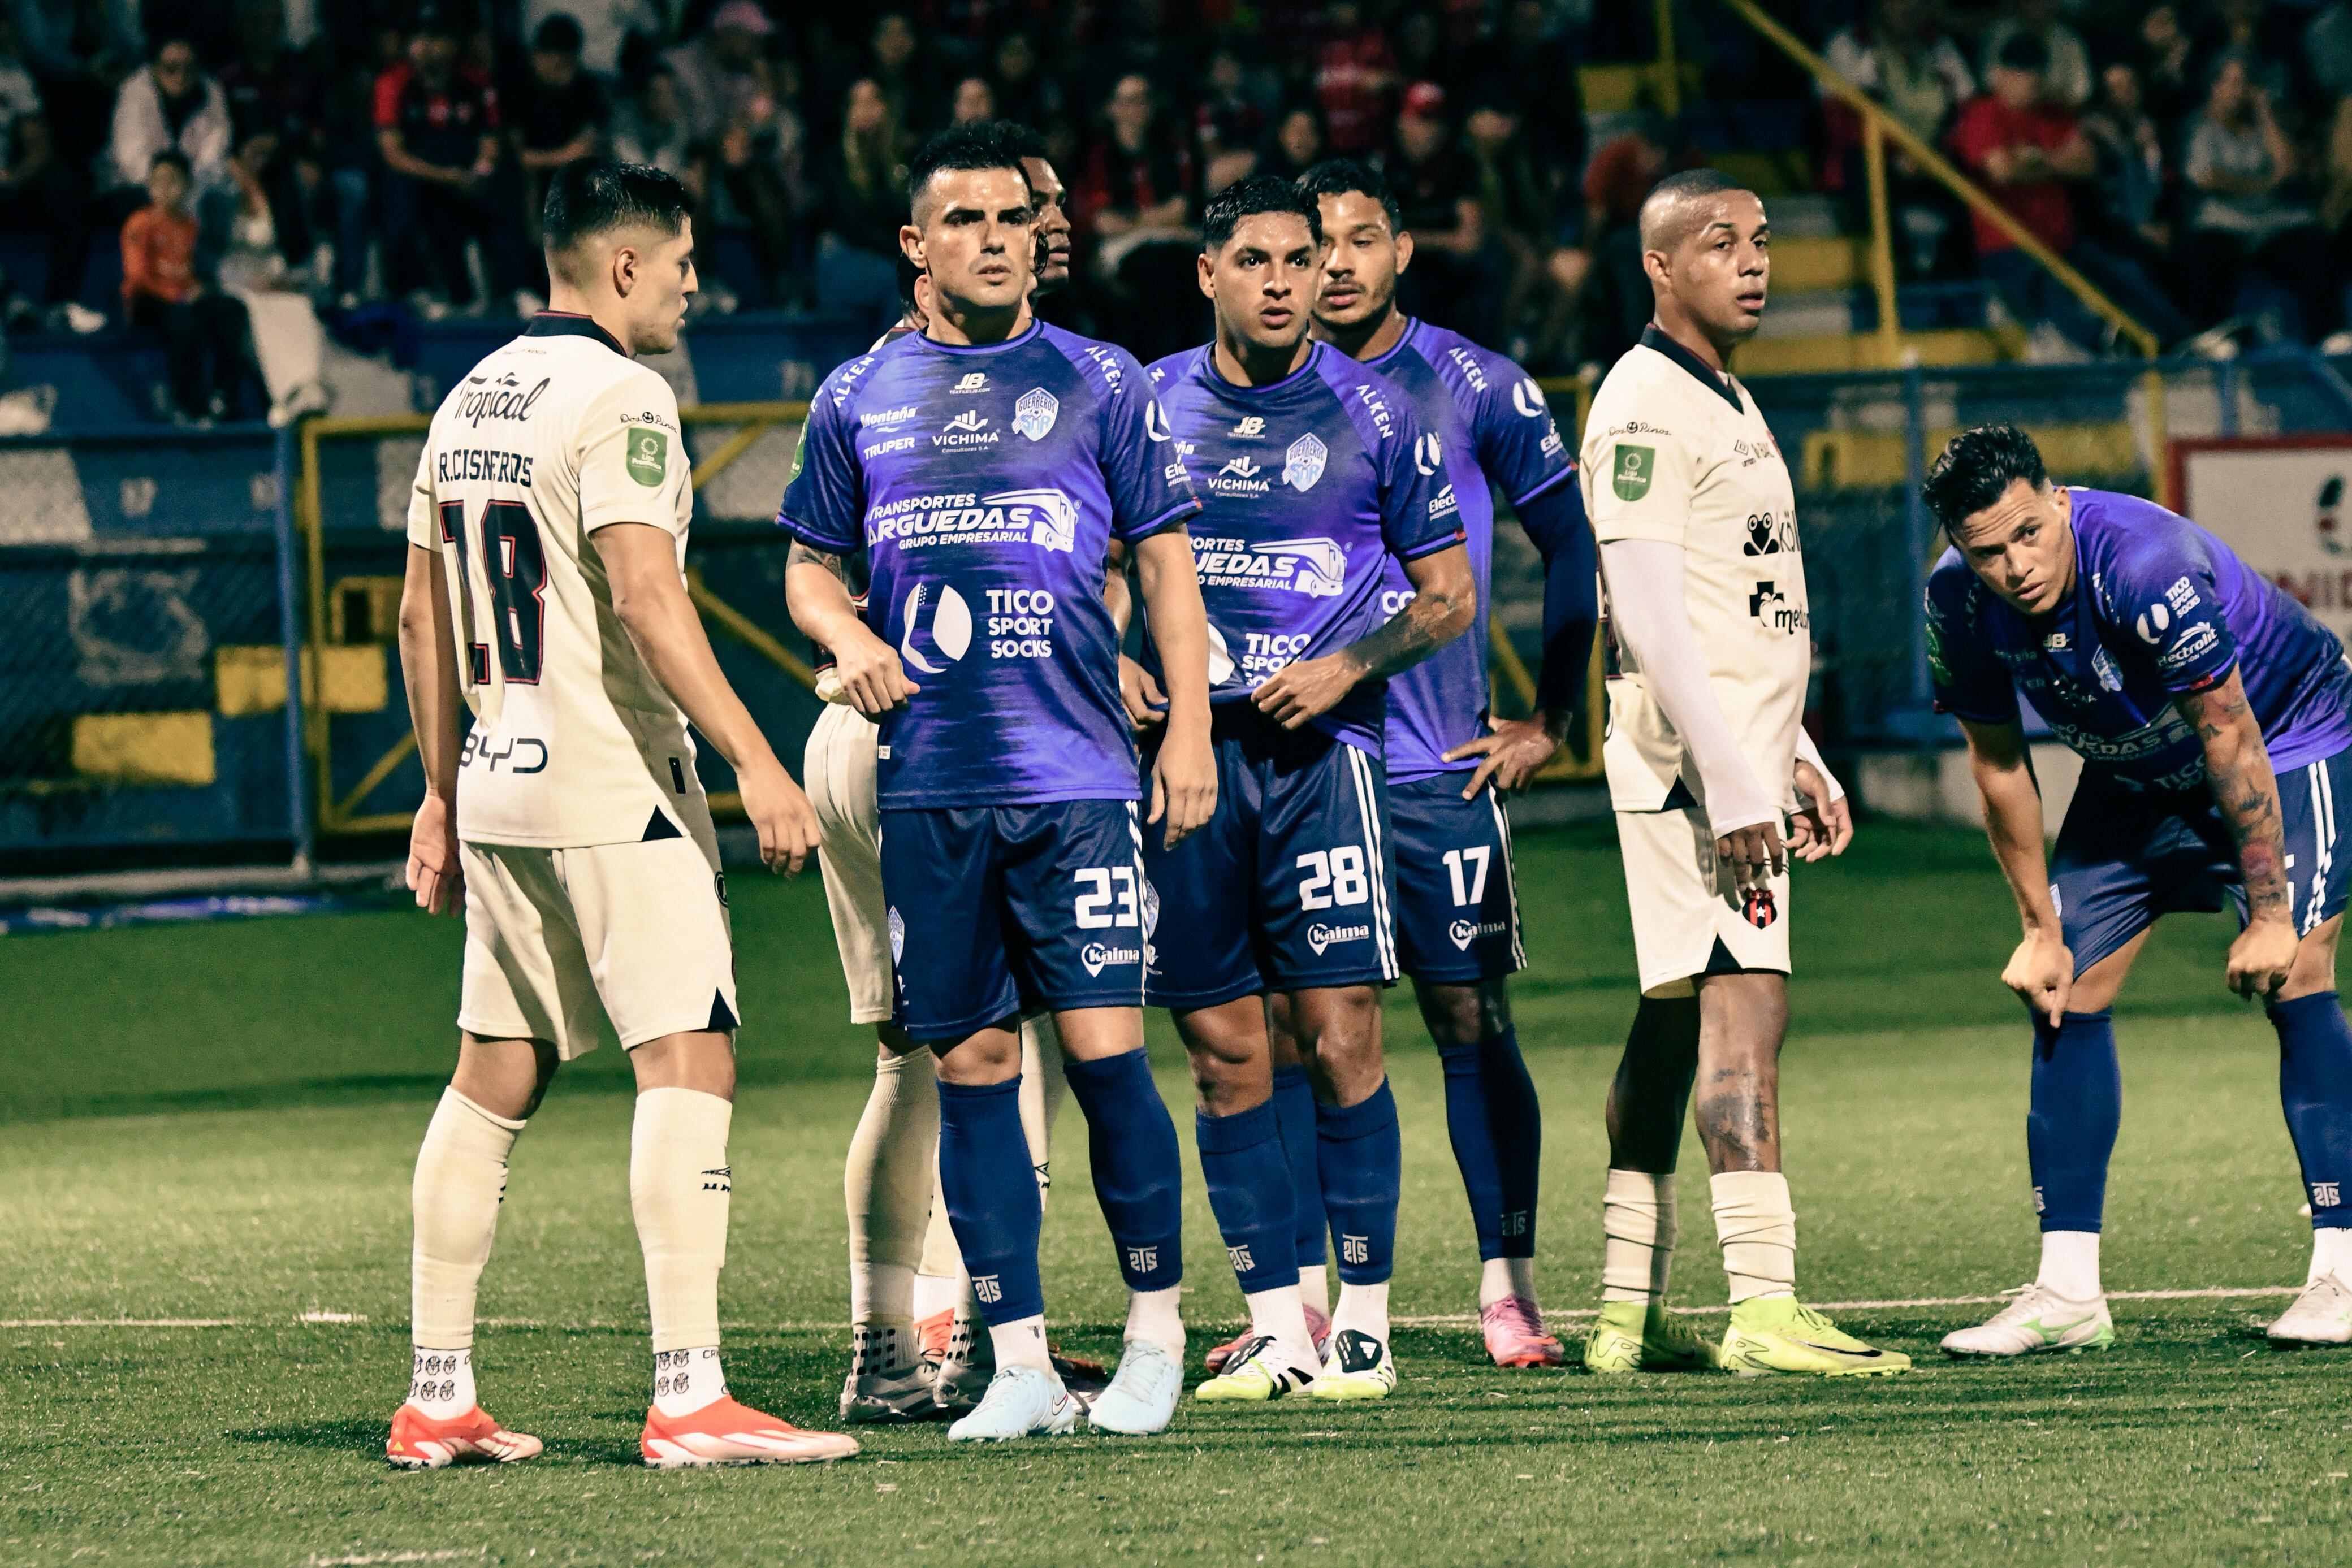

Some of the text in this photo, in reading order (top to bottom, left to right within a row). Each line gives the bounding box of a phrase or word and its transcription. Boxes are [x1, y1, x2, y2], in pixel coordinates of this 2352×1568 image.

[954, 372, 989, 389] JB
[1447, 346, 1488, 393] ALKEN
[833, 357, 875, 408] ALKEN
[455, 372, 550, 428] Tropical
[1018, 396, 1056, 413] GUERREROS
[1356, 384, 1394, 439] ALKEN
[1234, 416, 1266, 434] JB
[1609, 422, 1672, 436] Dos Pinos
[863, 437, 915, 460] TRUPER
[932, 432, 999, 446] VICHIMA
[1289, 443, 1324, 461] GUERREROS
[439, 449, 534, 487] R.CISNEROS
[1208, 478, 1270, 492] VICHIMA
[869, 493, 977, 521] TRANSPORTES
[1429, 492, 1456, 514] Elect
[868, 508, 1034, 548] ARGUEDAS
[898, 531, 1028, 550] GRUPO EMPRESARIAL
[1189, 537, 1245, 552] ORTES
[1194, 552, 1299, 578] UEDAS
[439, 499, 547, 686] 18
[1207, 575, 1291, 590] EMPRESARIAL
[2165, 576, 2190, 601] TICO
[986, 589, 1054, 614] TICO
[989, 617, 1053, 637] SPORT
[991, 639, 1053, 659] SOCKS
[1246, 633, 1312, 656] TICO
[1241, 655, 1302, 673] SPO
[460, 734, 548, 774] BYD
[1296, 845, 1369, 911] 28
[1442, 845, 1491, 907] 17
[1074, 866, 1139, 929] 23
